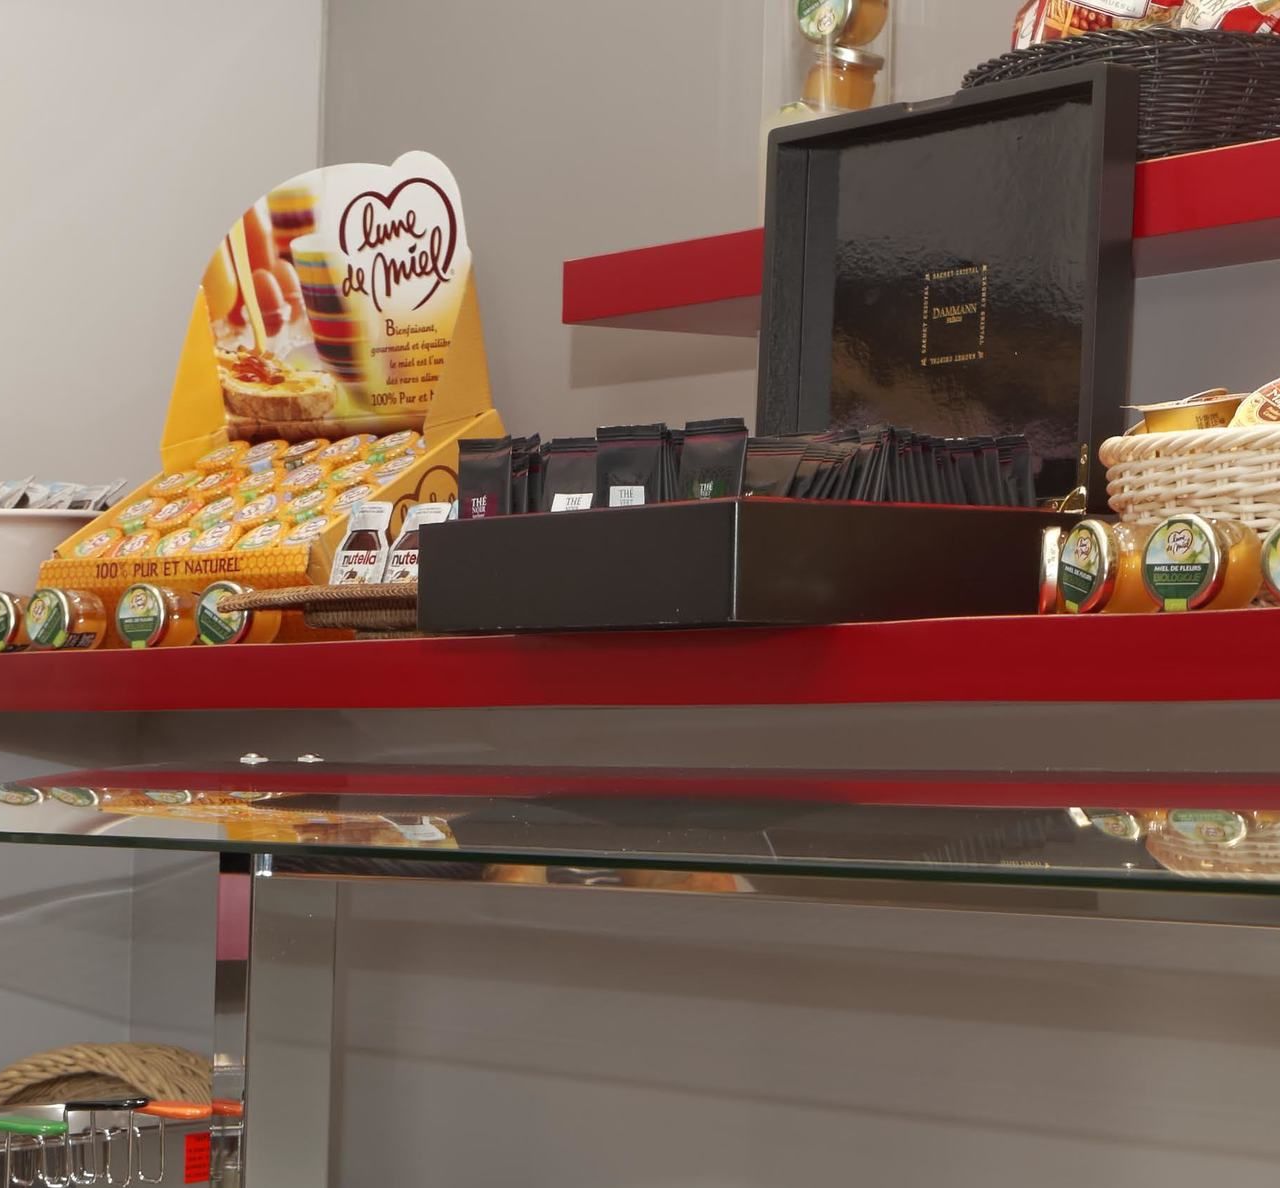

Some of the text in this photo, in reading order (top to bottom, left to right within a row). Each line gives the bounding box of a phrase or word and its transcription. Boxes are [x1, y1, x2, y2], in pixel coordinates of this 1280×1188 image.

[932, 303, 978, 319] DAMMANN
[372, 391, 397, 407] 100%
[399, 391, 416, 404] Pur
[342, 550, 377, 567] nutella
[95, 557, 242, 579] 100% PUR ET NATUREL
